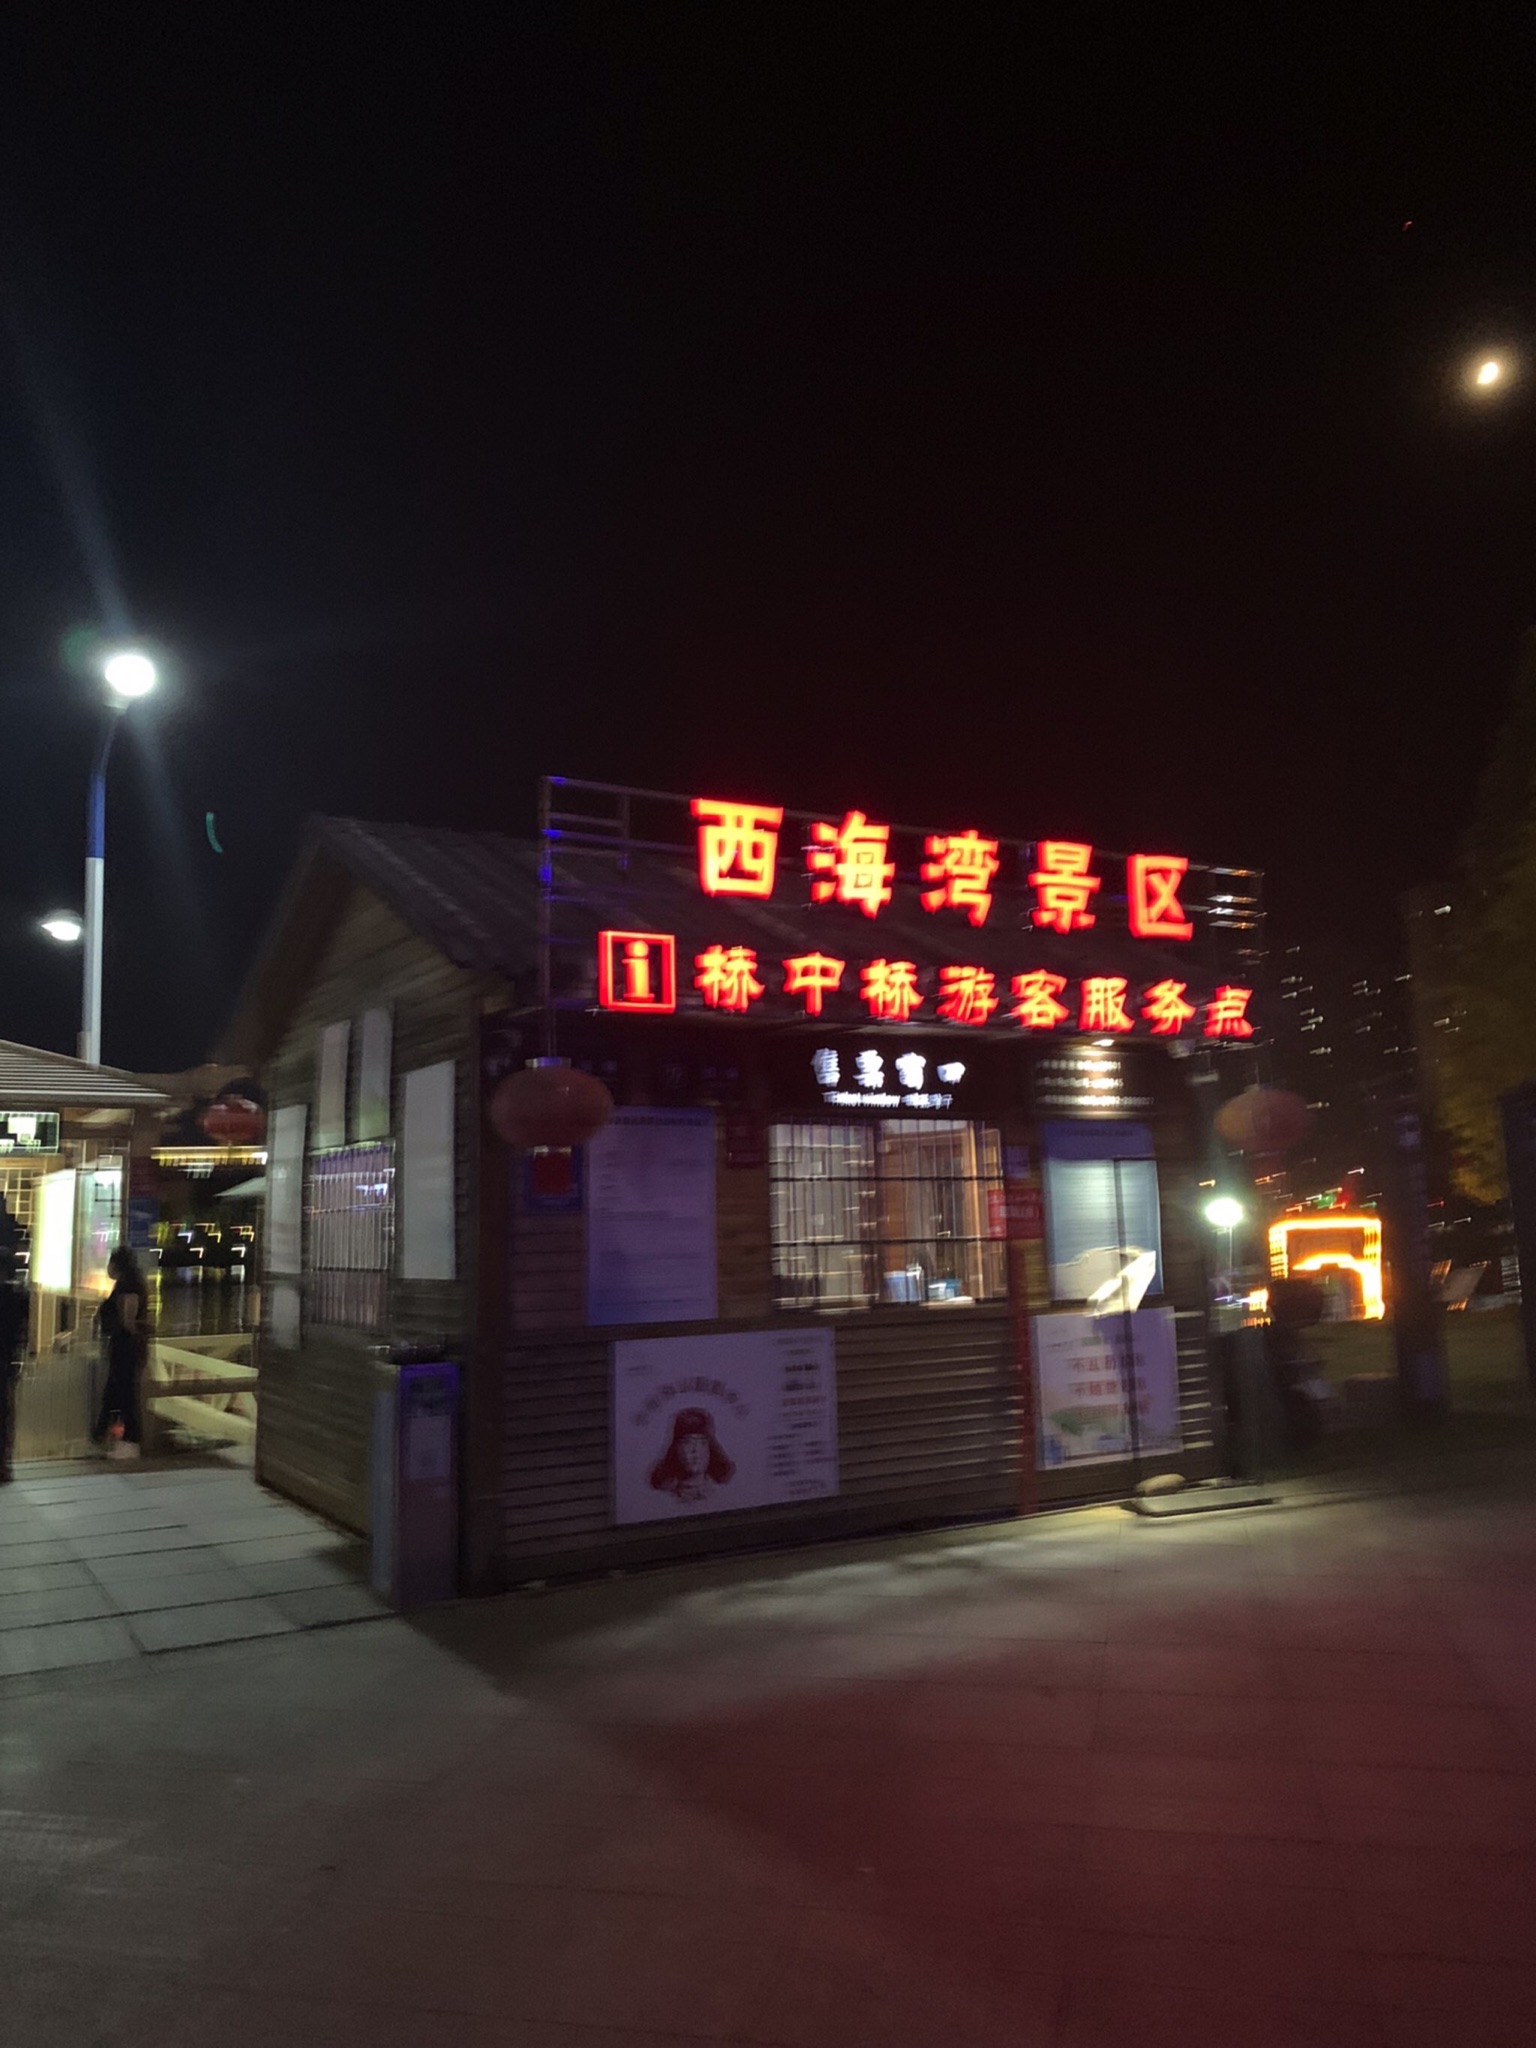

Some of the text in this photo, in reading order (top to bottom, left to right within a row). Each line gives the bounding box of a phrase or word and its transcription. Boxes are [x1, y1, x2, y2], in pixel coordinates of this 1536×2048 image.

[691, 797, 1194, 941] 西海湾景区
[694, 944, 1254, 1038] 桥中桥游客服务点
